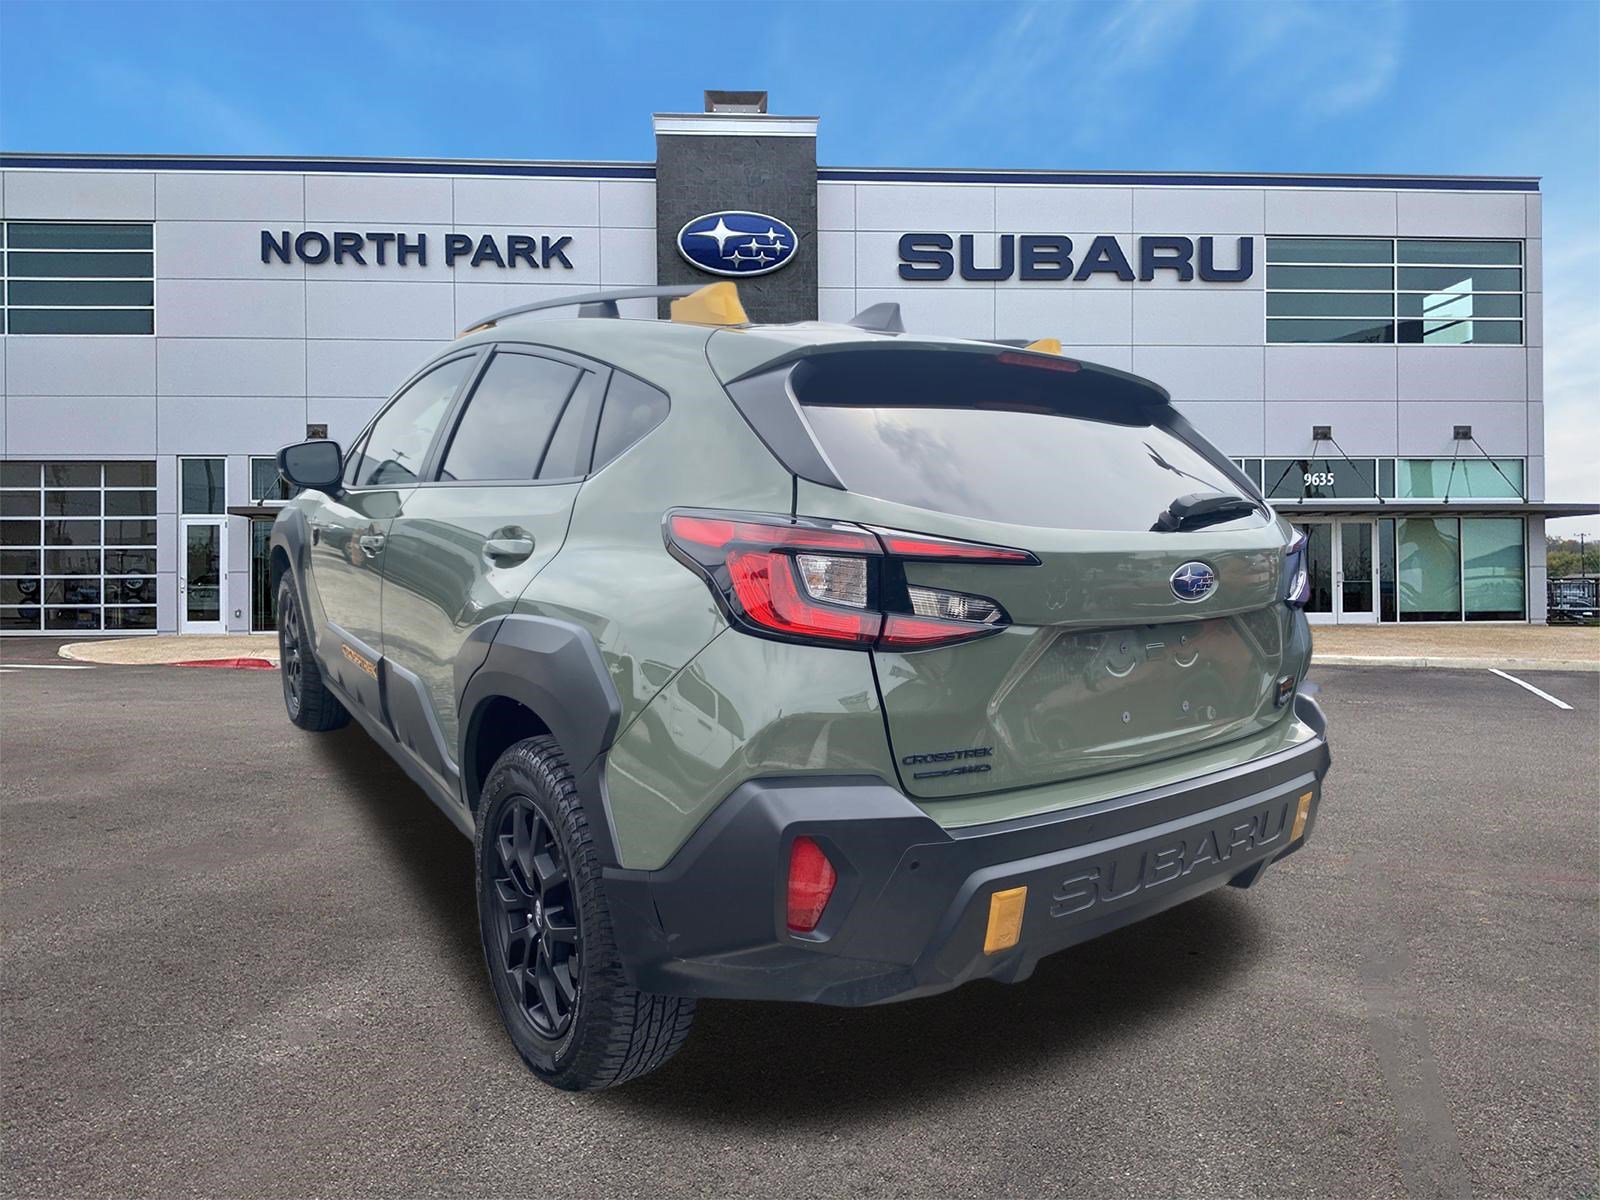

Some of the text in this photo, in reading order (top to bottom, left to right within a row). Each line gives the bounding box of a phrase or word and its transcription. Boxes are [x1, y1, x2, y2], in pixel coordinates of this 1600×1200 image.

[261, 231, 573, 268] NORTH PARK
[898, 233, 1254, 281] SUBARU
[1304, 472, 1334, 486] 9635
[902, 748, 993, 766] CROSSTREK
[1050, 803, 1288, 918] SUBARU
